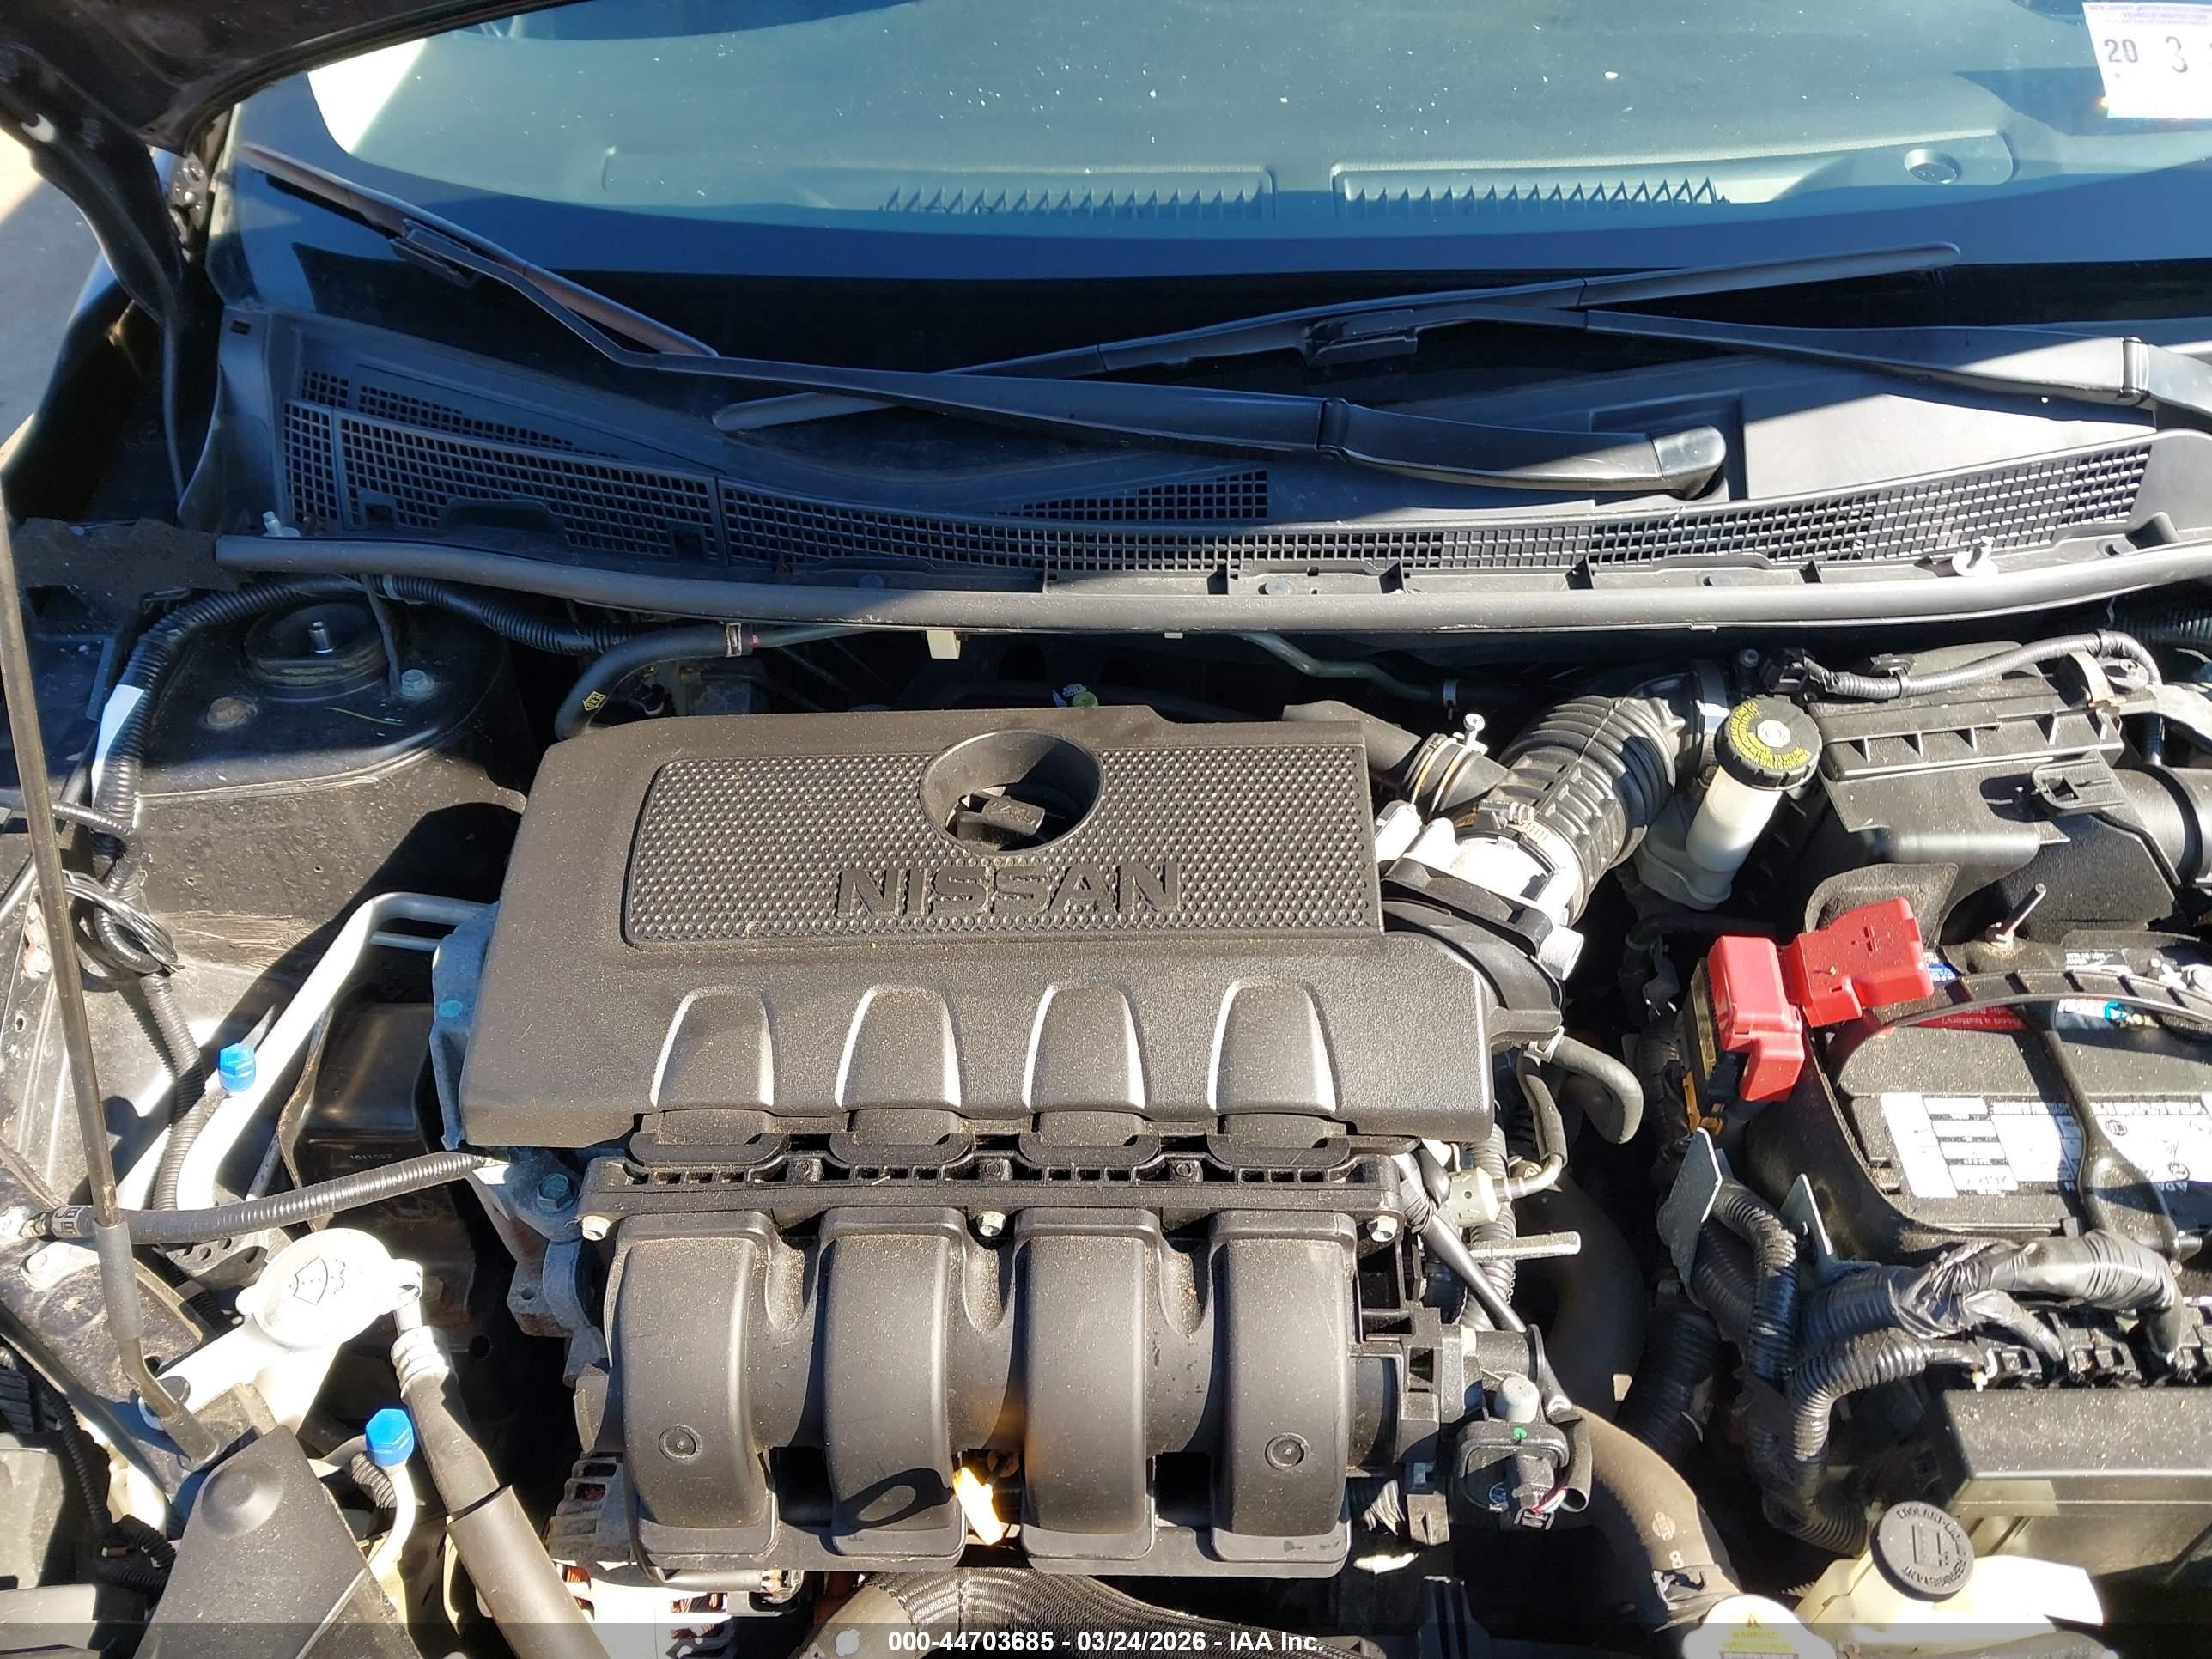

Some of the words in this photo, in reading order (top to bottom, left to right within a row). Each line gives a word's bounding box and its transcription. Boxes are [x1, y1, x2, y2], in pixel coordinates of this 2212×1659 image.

[2104, 39, 2138, 63] 20
[2165, 36, 2189, 73] 3
[836, 866, 1182, 917] NISSAN
